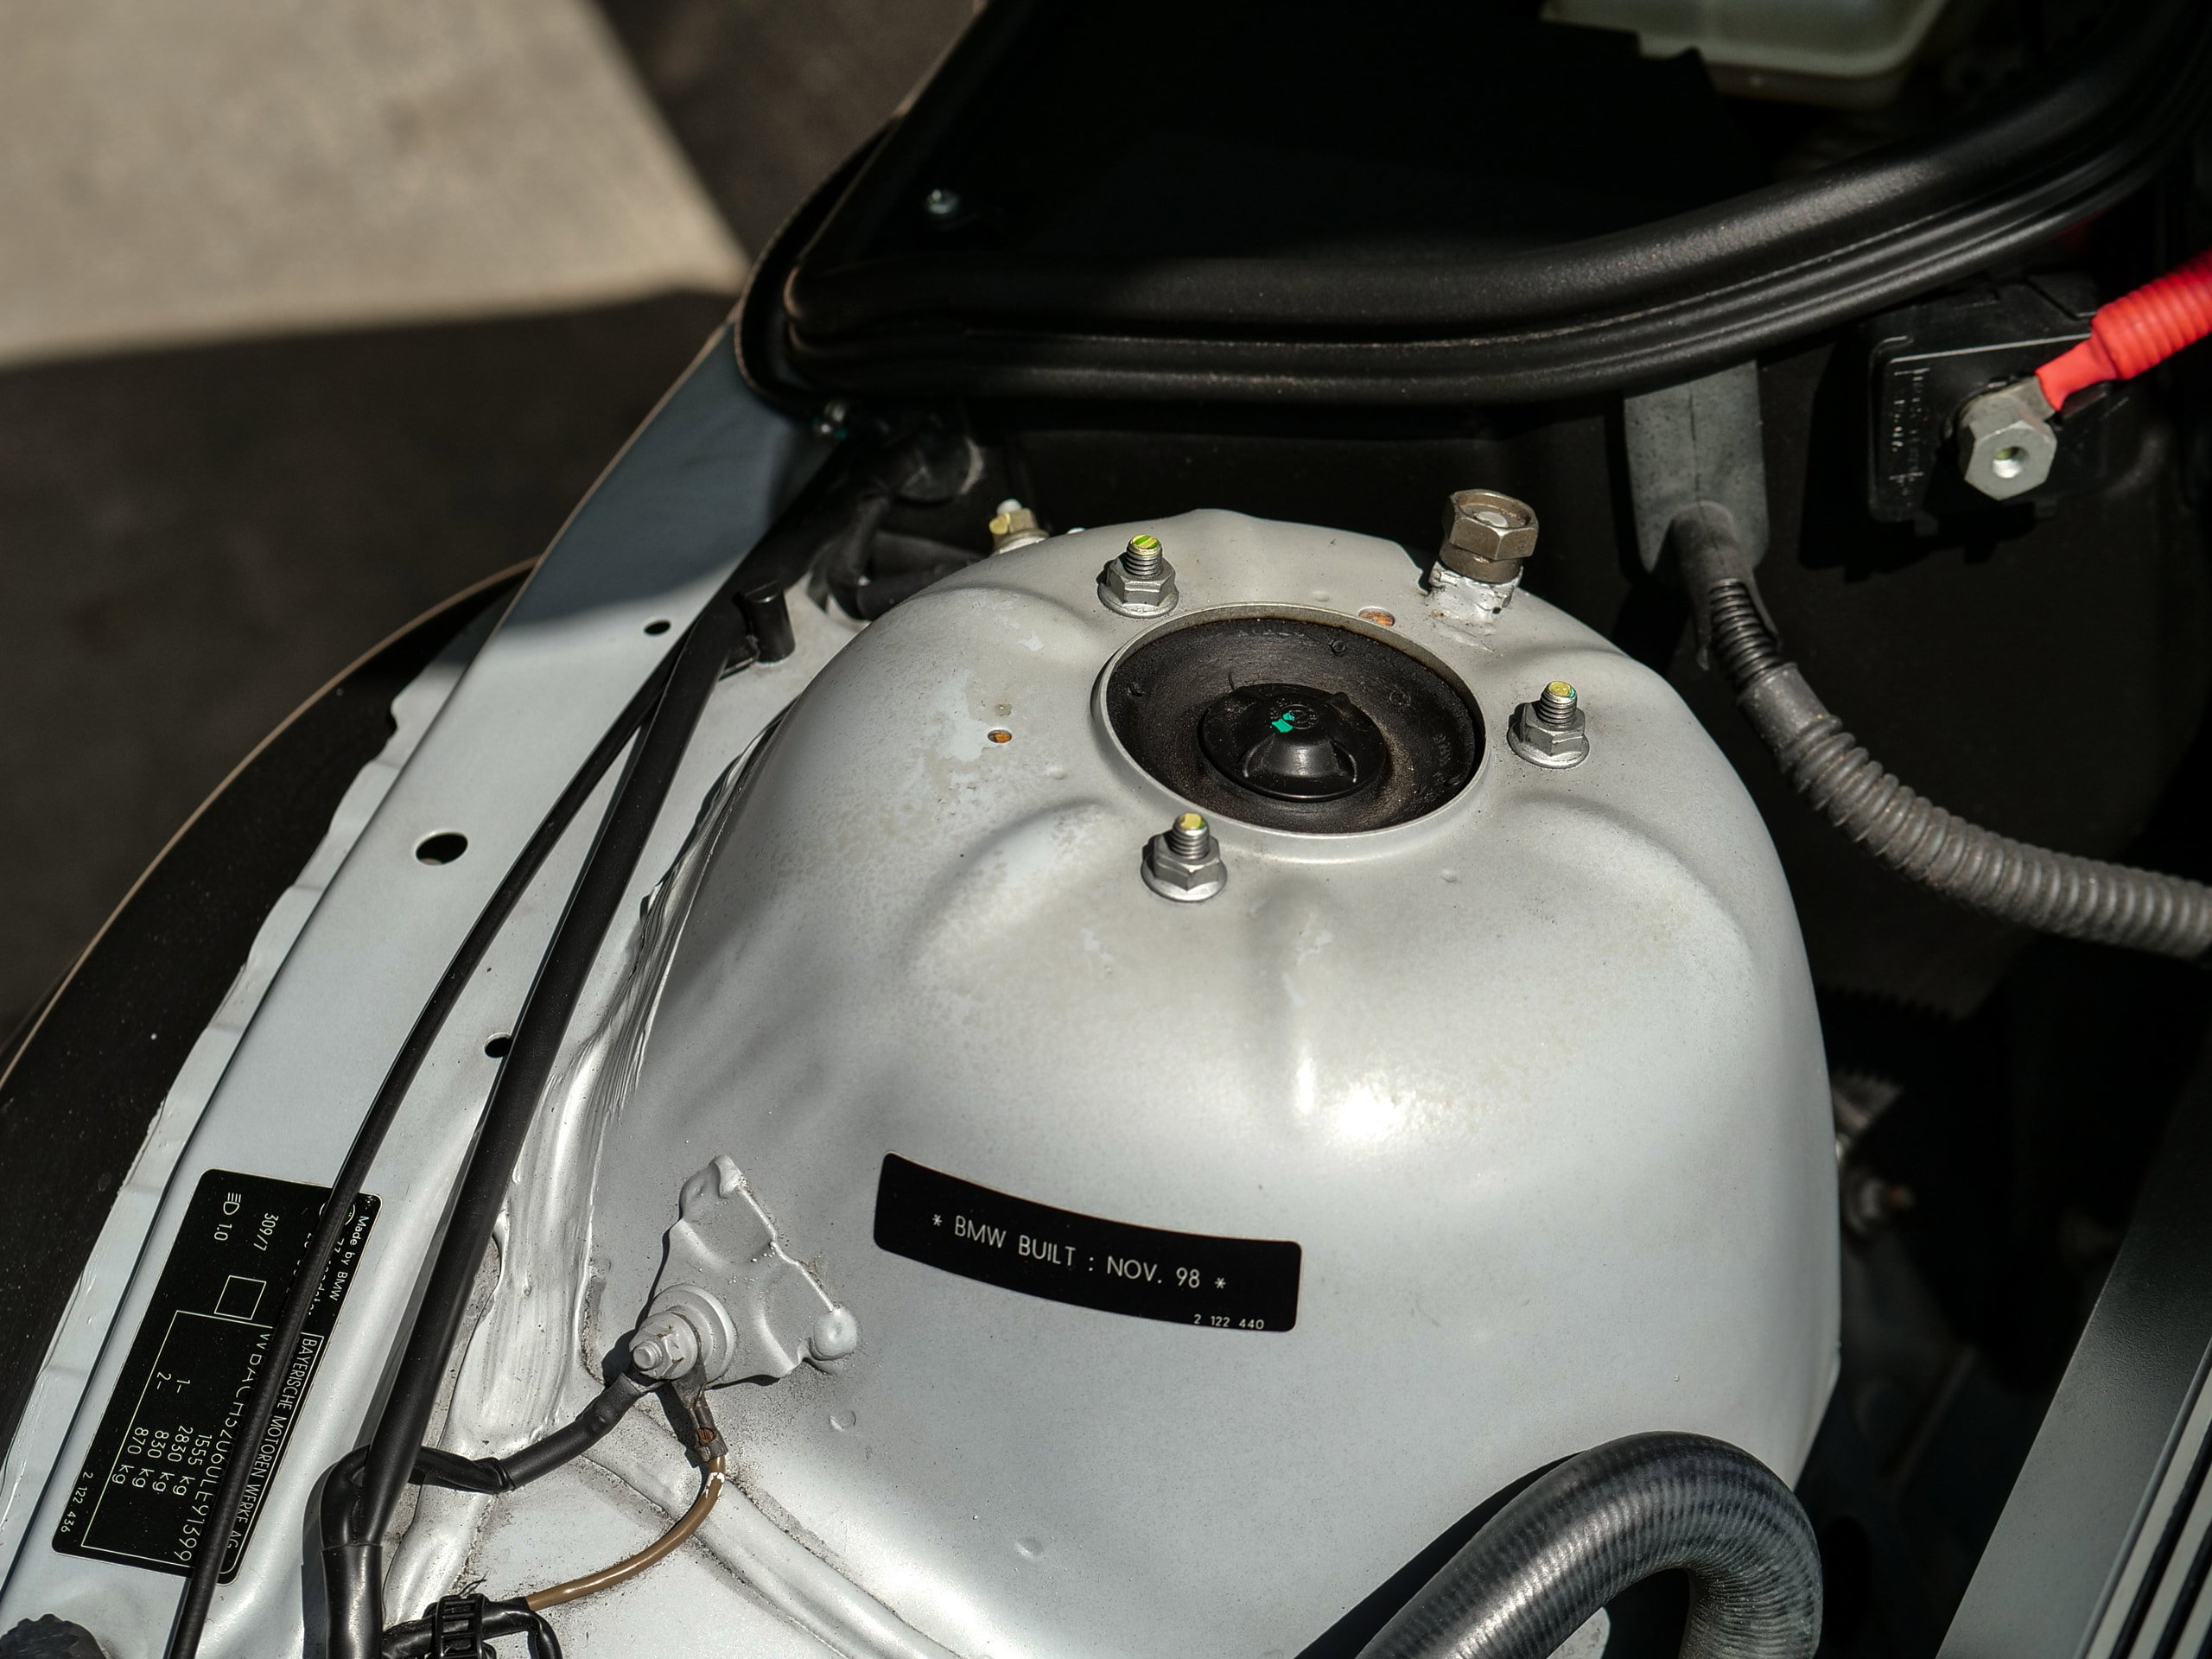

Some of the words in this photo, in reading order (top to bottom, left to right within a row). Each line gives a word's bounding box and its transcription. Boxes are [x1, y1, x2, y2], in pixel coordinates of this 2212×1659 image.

[213, 1224, 232, 1241] 1.0
[253, 1212, 279, 1251] 309/7
[349, 1215, 370, 1246] Made
[340, 1251, 356, 1266] by
[955, 1215, 1007, 1249] BMW
[1018, 1234, 1076, 1266] BUILT
[1107, 1255, 1162, 1284] NOV.
[1176, 1267, 1200, 1288] 98
[329, 1271, 348, 1301] BMW
[1192, 1313, 1203, 1326] 2
[1210, 1314, 1231, 1329] 122
[1238, 1318, 1266, 1332] 440
[276, 1338, 318, 1410] BAYERISCHE
[127, 1427, 149, 1455] 870
[147, 1430, 169, 1459] 830
[167, 1425, 194, 1463] 2830
[188, 1434, 213, 1465] 1555
[251, 1415, 288, 1479] MOTOREN
[111, 1464, 135, 1484] kg
[131, 1467, 156, 1489] kg
[151, 1471, 175, 1492] kg
[172, 1475, 196, 1497] kg
[72, 1486, 88, 1504] 122
[236, 1484, 261, 1523] WERKE
[60, 1510, 77, 1533] 436
[225, 1529, 242, 1550] AG
